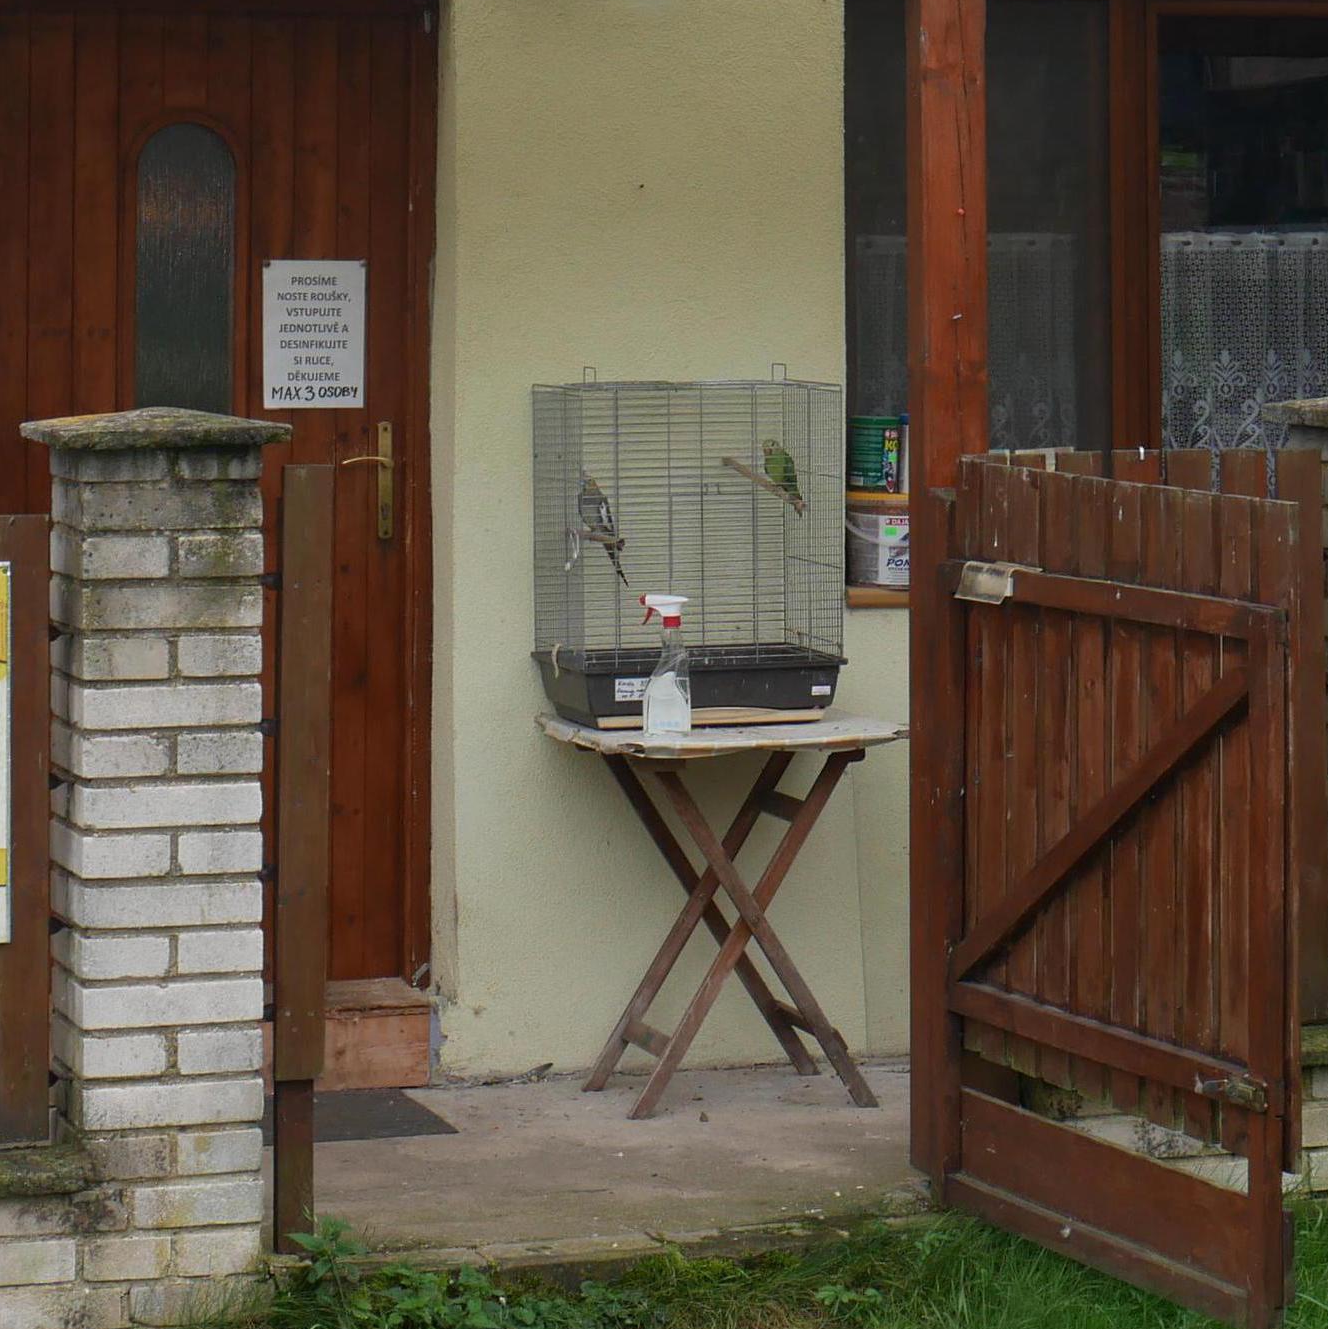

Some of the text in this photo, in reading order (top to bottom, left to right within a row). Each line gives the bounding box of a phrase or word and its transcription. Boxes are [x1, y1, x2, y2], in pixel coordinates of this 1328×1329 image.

[291, 274, 338, 286] PROSÍME
[277, 290, 351, 303] NOSTE ROUŠKY,
[286, 307, 342, 317] VSTUPUJTE
[278, 322, 349, 333] JEDNOTLIVĚ A
[280, 339, 348, 349] DESINFIKUJTE
[293, 355, 335, 367] SI RUCE,
[287, 370, 341, 382] DĚKUJEME
[304, 385, 316, 401] 3
[318, 386, 358, 398] OSOBY
